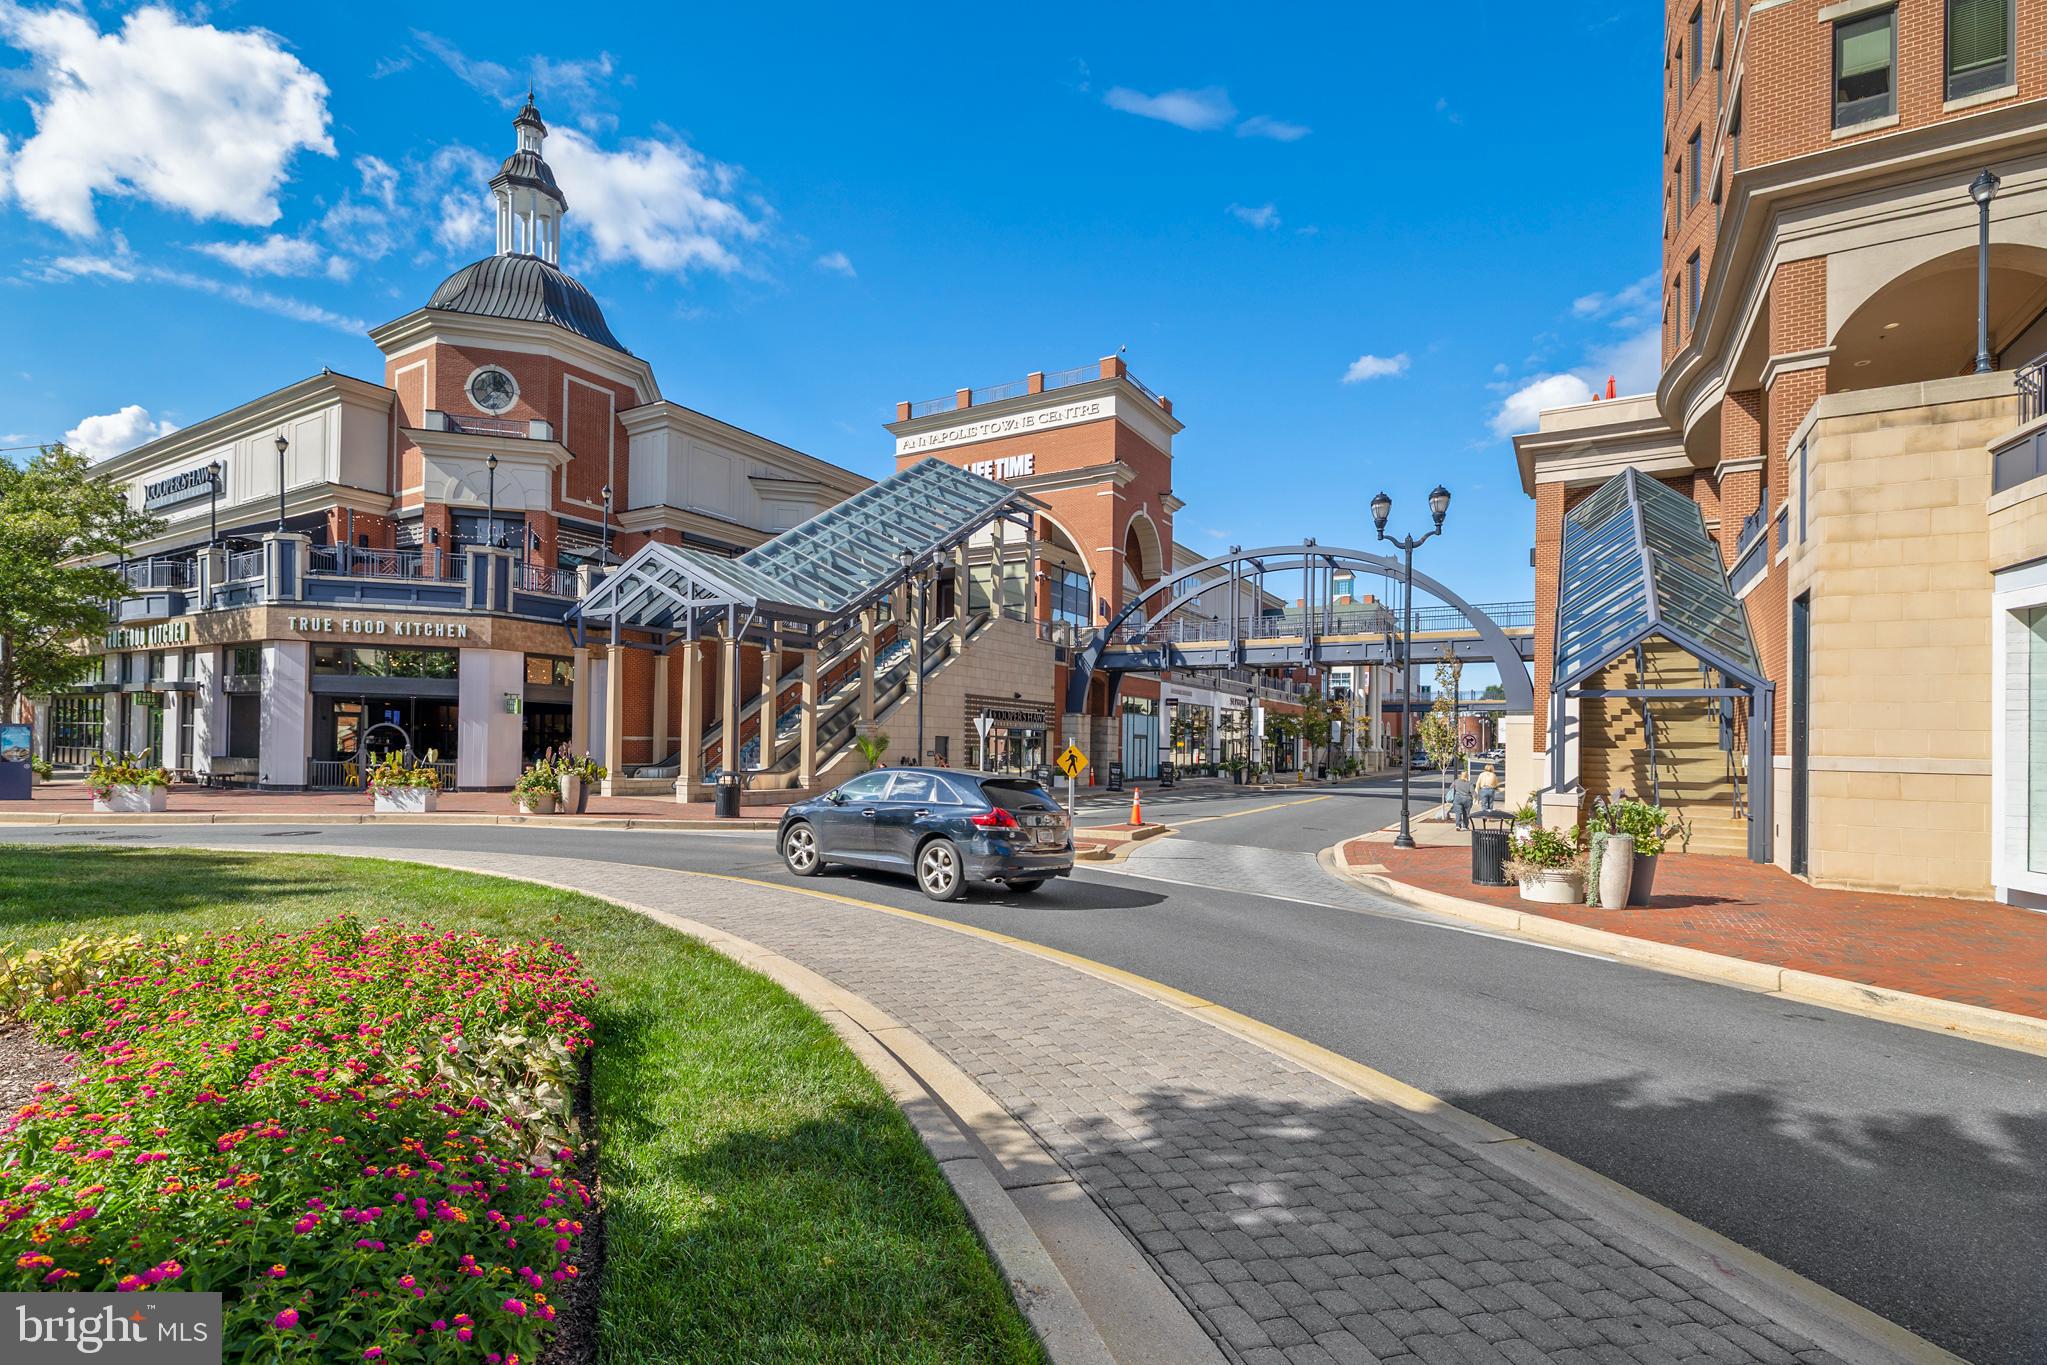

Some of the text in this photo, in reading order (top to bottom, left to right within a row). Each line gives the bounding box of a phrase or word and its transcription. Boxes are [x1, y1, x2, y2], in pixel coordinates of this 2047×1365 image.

[903, 403, 1100, 450] ANNAPOLIS TOWNE CENTRE
[188, 466, 211, 489] HAW
[963, 453, 1034, 480] IFE TIME
[124, 627, 146, 647] FOOD
[148, 622, 186, 644] KITCHEN
[288, 616, 467, 638] TRUE FOOD KITCHEN
